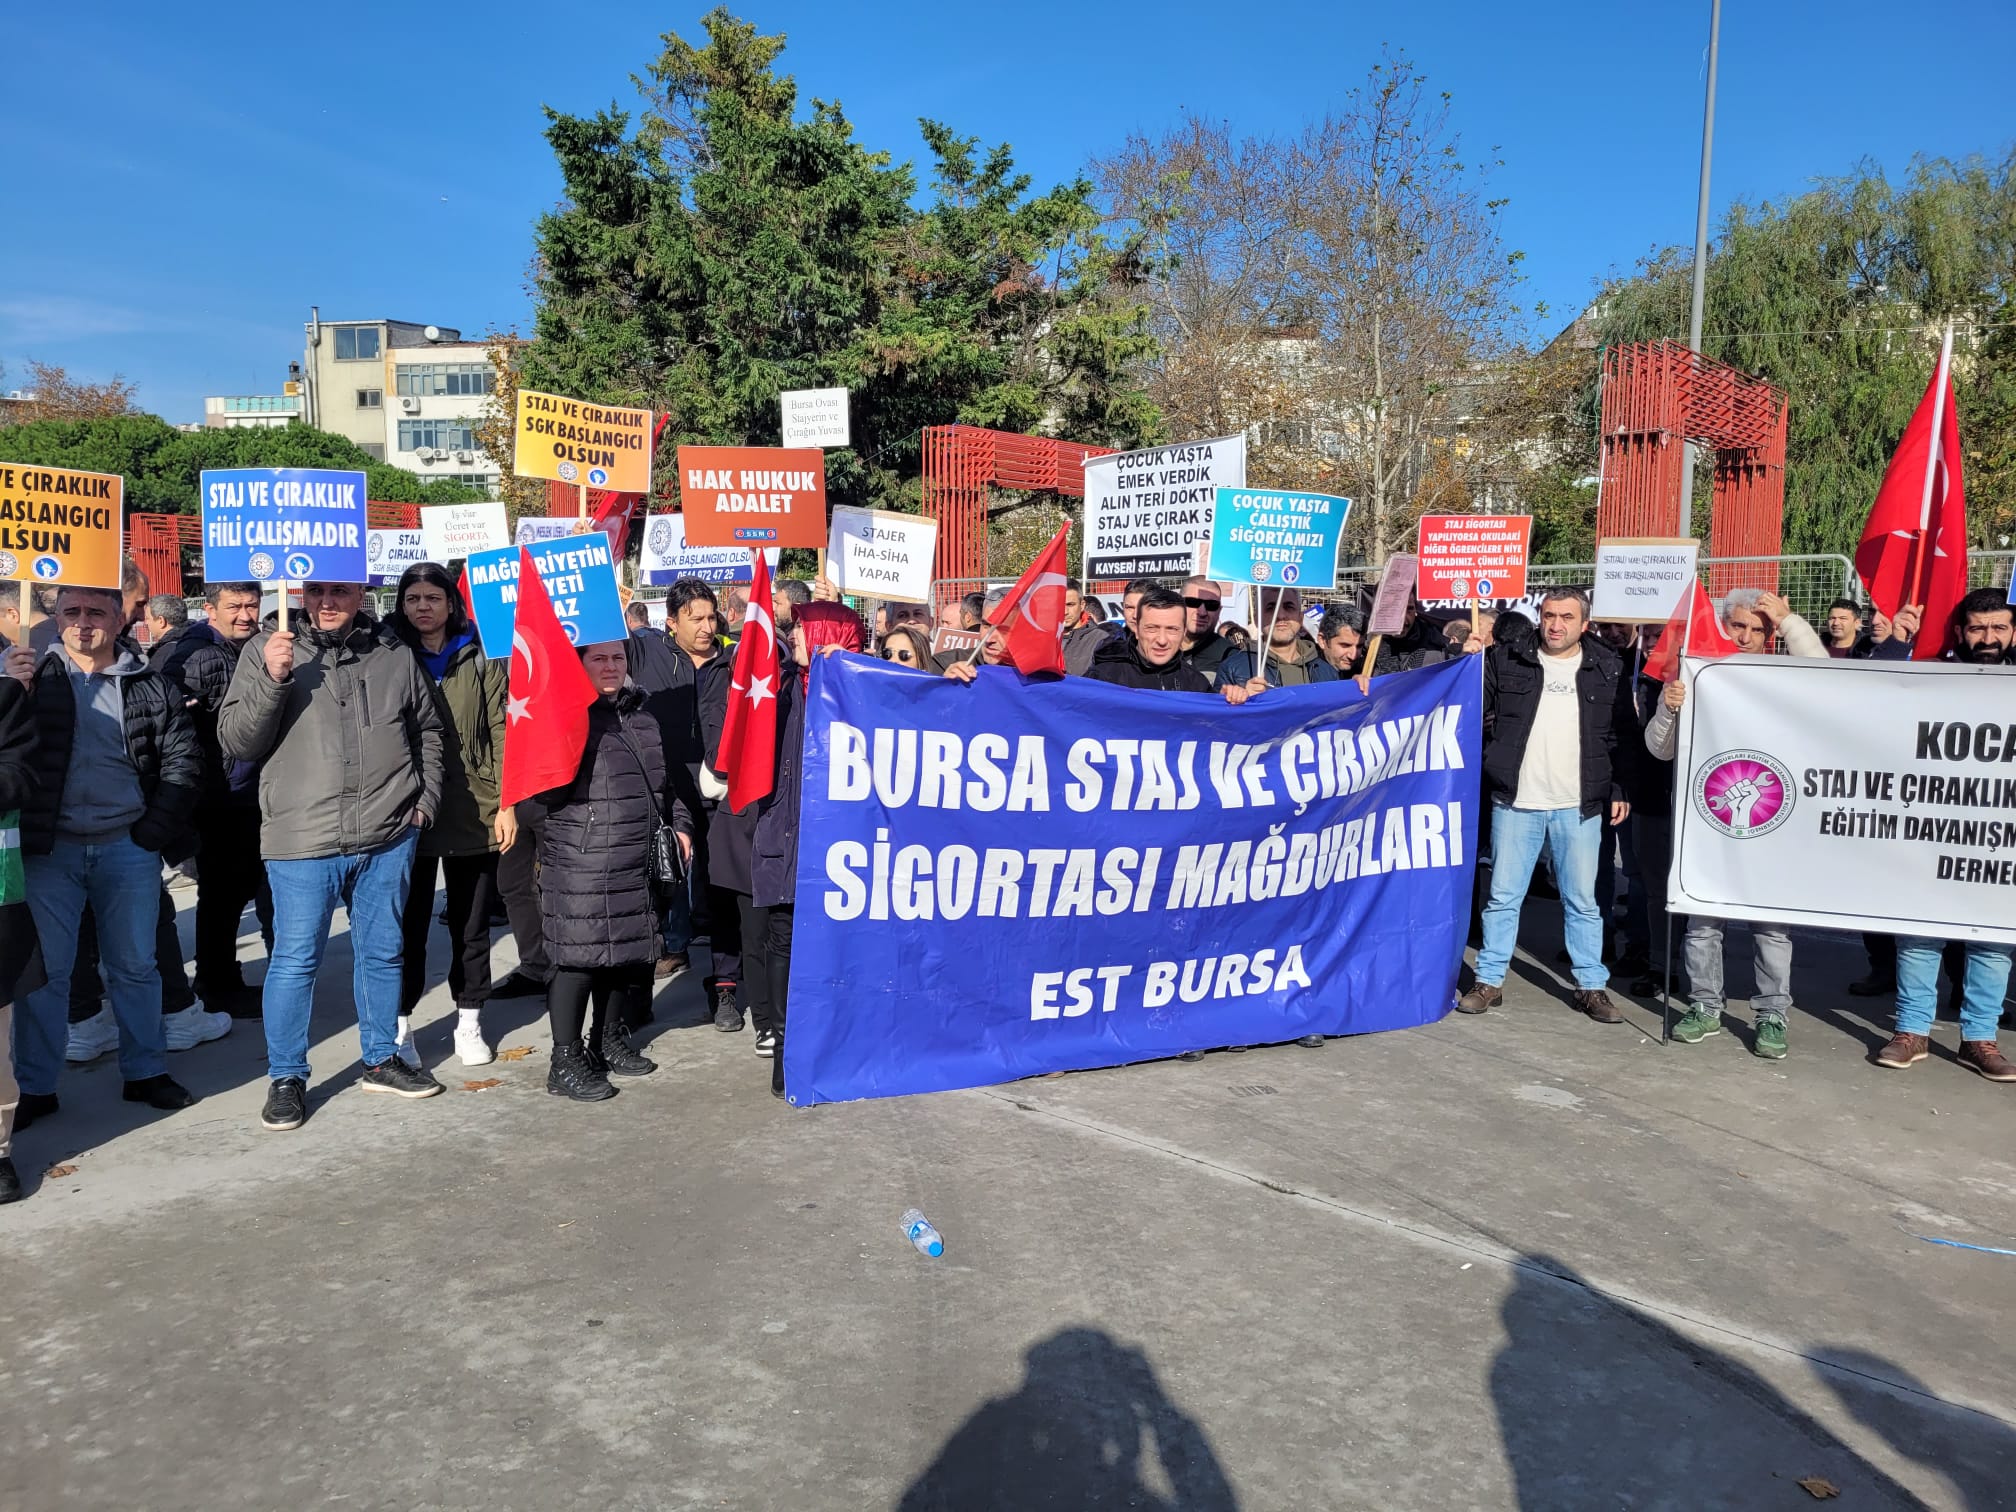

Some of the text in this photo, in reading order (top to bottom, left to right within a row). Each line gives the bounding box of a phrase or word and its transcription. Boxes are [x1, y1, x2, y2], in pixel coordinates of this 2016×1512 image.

[526, 396, 643, 428] STAJ VE ÇIRAKLIK
[791, 399, 838, 409] Bursa Ovası
[526, 416, 643, 450] SGK BAŞLANGICI
[553, 442, 615, 467] OLSUN
[1117, 446, 1213, 473] ÇOCUK YAŞTA
[22, 471, 110, 499] ÇIRAKLIK
[688, 469, 816, 492] HAK HUKUK
[1118, 464, 1211, 489] EMEK VERDİK
[209, 482, 356, 514] STAJ VE ÇIRAKLIK
[715, 493, 793, 513] ADALET
[1101, 495, 1131, 511] ALIN
[1135, 488, 1165, 507] TERİ
[1098, 515, 1130, 530] STAJ
[1135, 513, 1151, 528] VE
[1155, 509, 1200, 529] ÇIRAK
[1444, 518, 1507, 529] STAJ SİGORTASI
[398, 534, 420, 546] STAJ
[862, 526, 906, 543] STAJER
[1097, 531, 1178, 552] BAŞLANGICI
[1229, 525, 1325, 547] SİGORTAMIZI
[473, 544, 608, 585] MAĞDRİYETİN
[662, 551, 750, 568] SGK BAŞLANGICI OLSU
[853, 543, 909, 564] İHA-SİHA
[1250, 544, 1303, 563] İSTERİZ
[712, 569, 723, 581] 47
[723, 569, 735, 580] 25
[858, 566, 900, 583] YAPAR
[1095, 559, 1136, 575] KAYSERİ
[1138, 561, 1161, 574] STAJ
[828, 705, 1465, 816] BURSA STAJ VE ÇIRAKLIK
[1803, 768, 2016, 808] STAJ VE ÇIRAKLIK
[1819, 806, 1898, 840] EĞİTİM
[824, 802, 1463, 921] SİGORTASI MAĞDURLARI
[1936, 855, 2016, 886] DERNE
[1030, 944, 1311, 1021] EST BURSA
